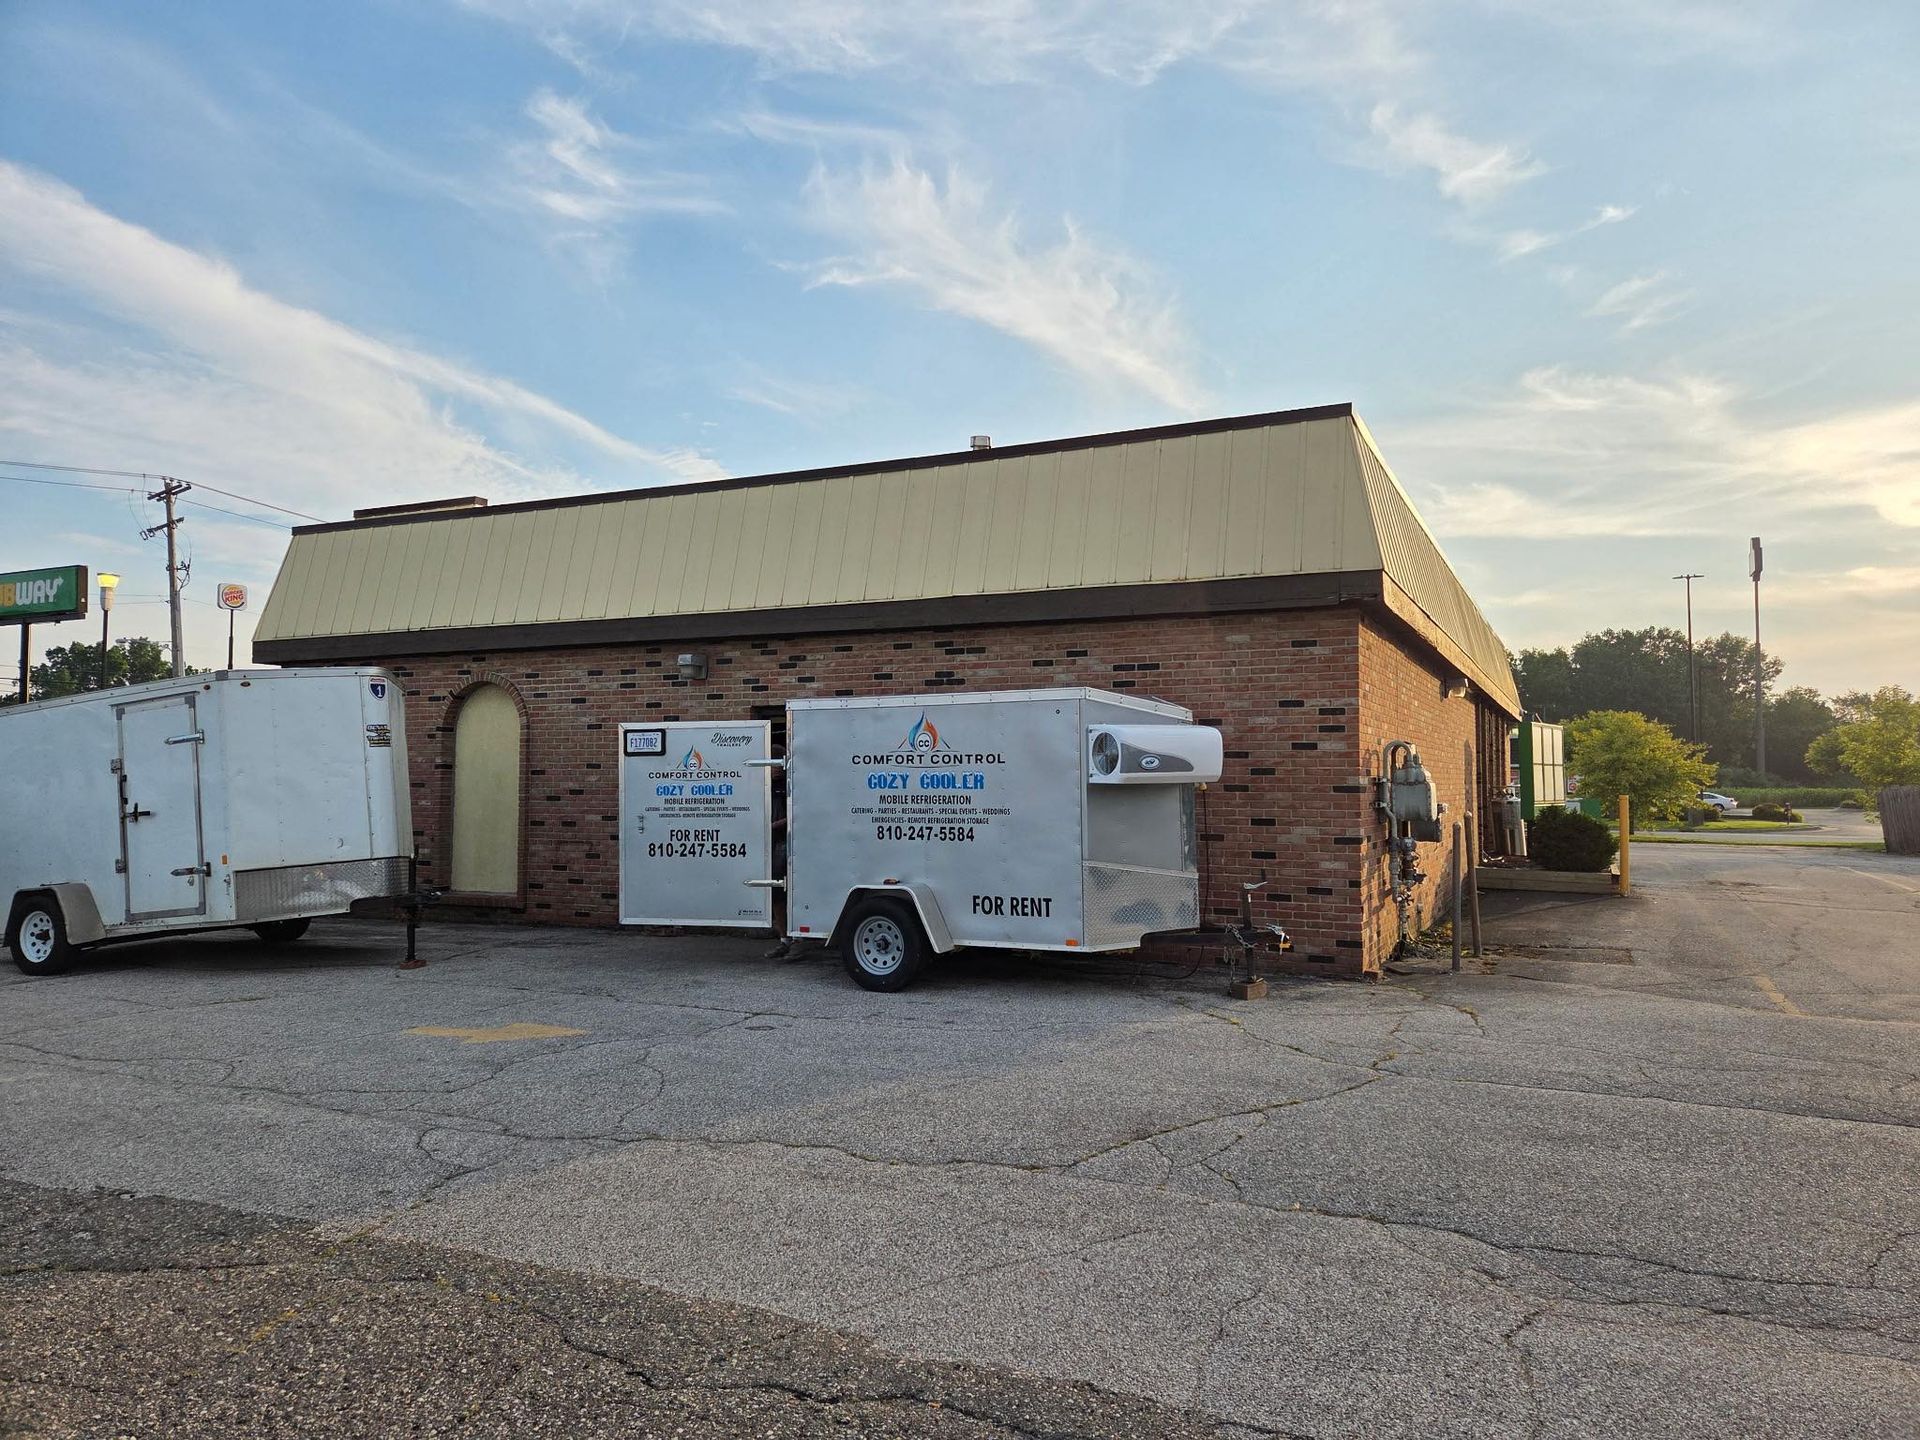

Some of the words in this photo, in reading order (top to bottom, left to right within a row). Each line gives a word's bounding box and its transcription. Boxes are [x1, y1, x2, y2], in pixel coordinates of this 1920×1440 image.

[224, 594, 244, 602] KING
[376, 686, 382, 697] 1
[711, 732, 752, 746] Discovery
[852, 754, 925, 765] COMFORT
[930, 754, 1005, 764] CONTROL
[868, 772, 910, 790] COZY
[920, 771, 985, 790] COOLER
[656, 784, 684, 796] COZY
[690, 783, 733, 796] COOLER
[879, 795, 909, 805] MOBILE
[910, 795, 971, 805] REFRIGERATION
[670, 830, 690, 842] FOR
[694, 830, 720, 842] RENT
[877, 826, 975, 842] 810-247-5584
[648, 843, 747, 858] 810-247-5584
[972, 895, 1005, 916] FOR
[1010, 896, 1052, 918] RENT
